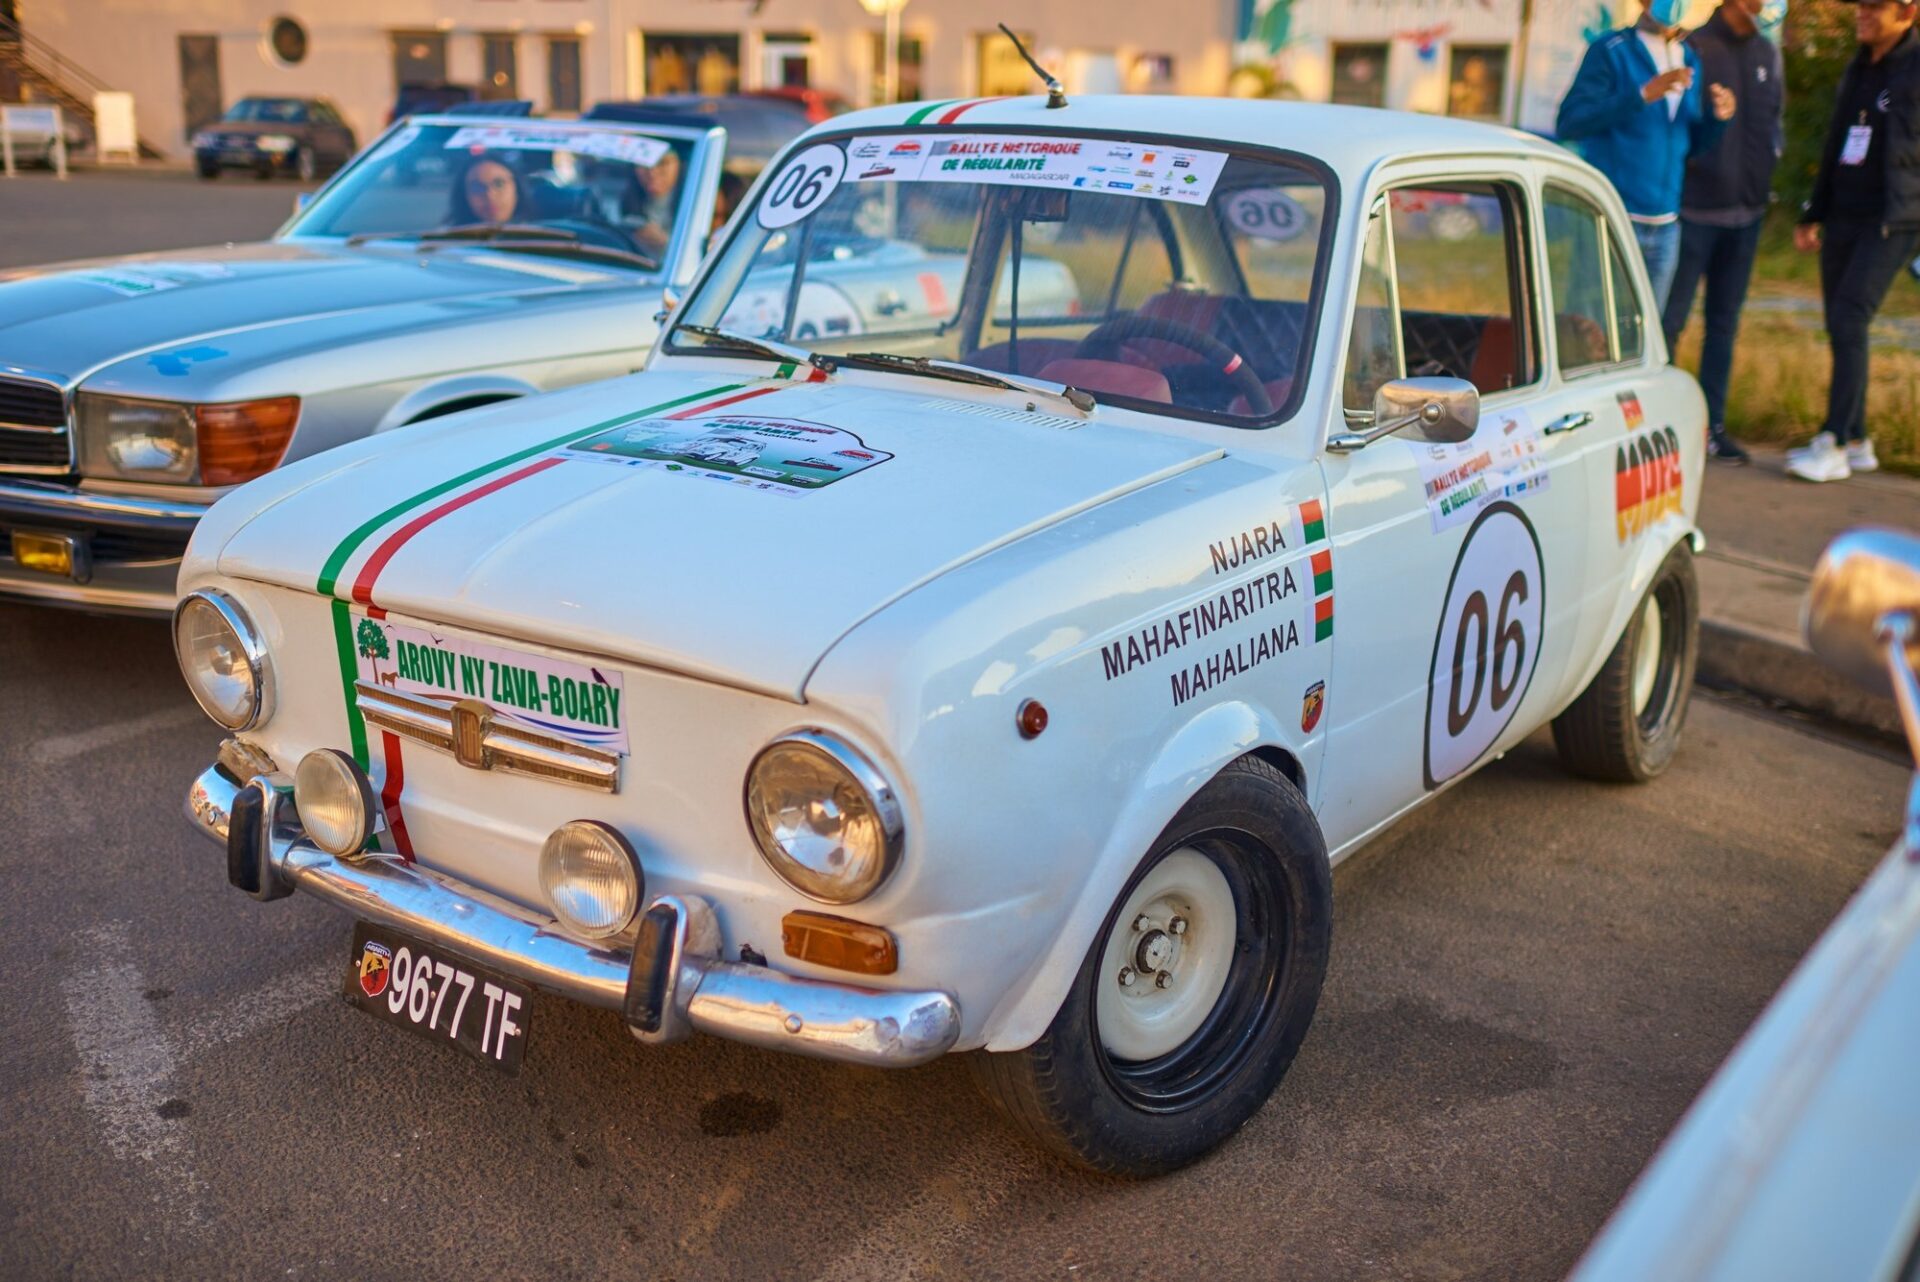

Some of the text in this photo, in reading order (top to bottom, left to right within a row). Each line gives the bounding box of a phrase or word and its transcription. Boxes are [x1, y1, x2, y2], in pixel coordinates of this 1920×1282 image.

[941, 154, 1047, 171] DE RÉGULARITÉ
[949, 142, 1082, 156] RALLYE HISTORIQUE
[1009, 172, 1071, 181] MADAGASCAR
[769, 163, 834, 210] 06
[1208, 521, 1287, 575] NJARA
[1100, 566, 1298, 681] MAHAFINARITRA
[1446, 569, 1529, 738] 06
[397, 639, 621, 729] AROVY NY ZAVA-BOARY
[1170, 619, 1299, 707] MAHALIANA
[387, 946, 523, 1061] 9677 TF
